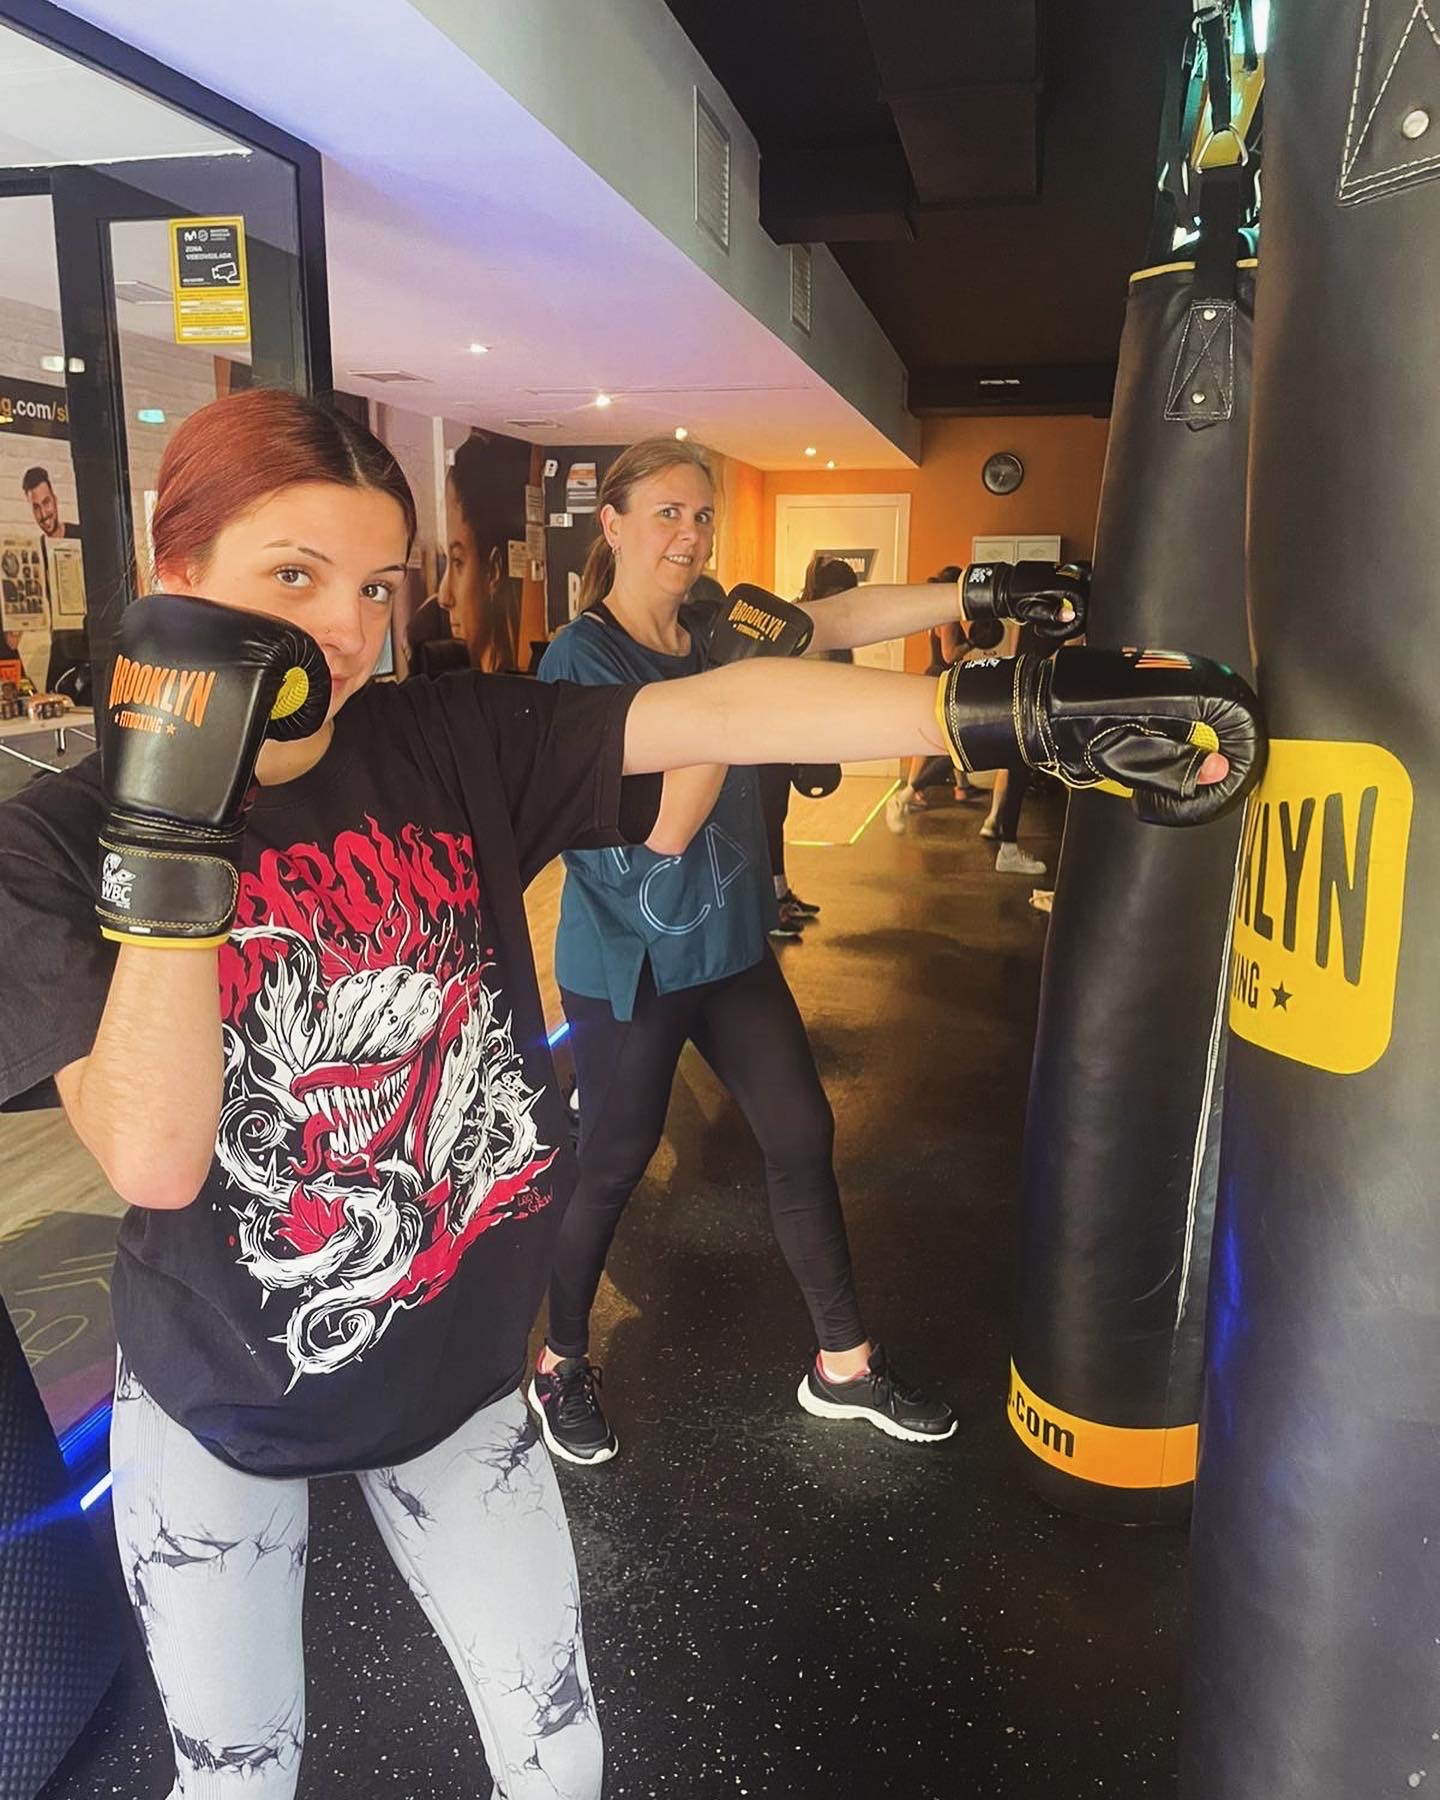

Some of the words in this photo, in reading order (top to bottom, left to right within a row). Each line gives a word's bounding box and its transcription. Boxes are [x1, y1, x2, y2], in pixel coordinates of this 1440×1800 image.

[728, 599, 785, 642] BROOKLYN
[102, 881, 132, 902] WBC
[1233, 952, 1260, 1009] ING
[1008, 1391, 1075, 1458] .com
